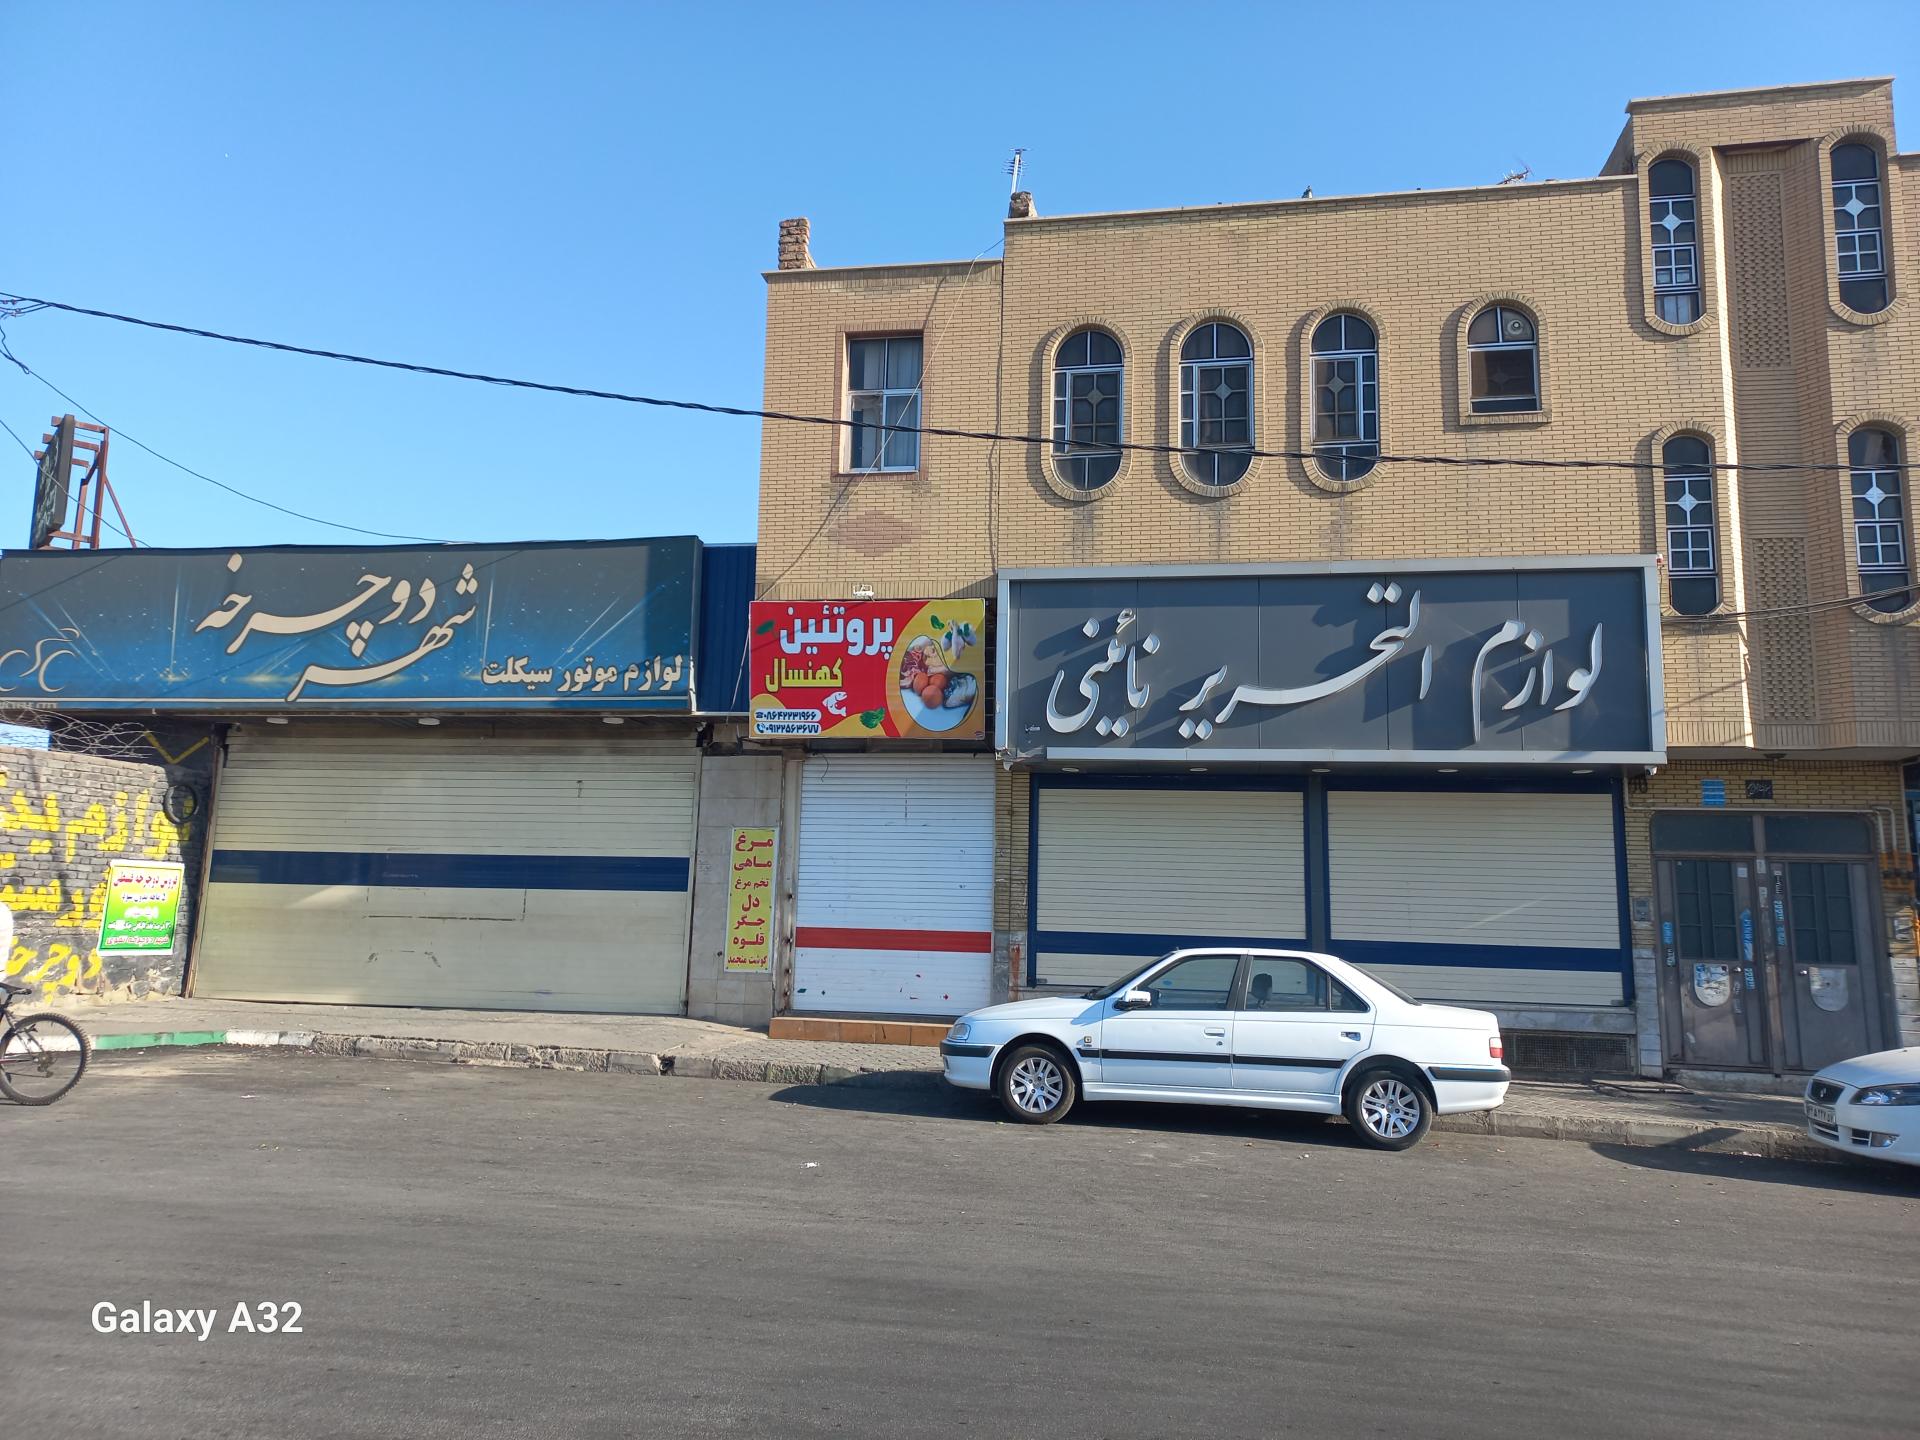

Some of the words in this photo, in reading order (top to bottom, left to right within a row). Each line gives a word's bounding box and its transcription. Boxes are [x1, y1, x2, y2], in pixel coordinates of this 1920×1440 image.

[194, 553, 436, 658] دوچرخه
[284, 563, 478, 702] شهر
[779, 605, 894, 660] پروتئین
[481, 656, 553, 690] سیکلت
[557, 656, 618, 692] موتور
[624, 655, 683, 691] لوازم
[765, 657, 844, 693] کهنسال
[1178, 582, 1433, 740] التحریر
[1472, 619, 1603, 743] لوازم
[735, 832, 774, 851] مرغ
[734, 856, 772, 871] ماهی
[735, 876, 752, 889] مرغ
[754, 877, 769, 890] تخم
[742, 894, 760, 912] دل
[733, 932, 765, 949] قلوه
